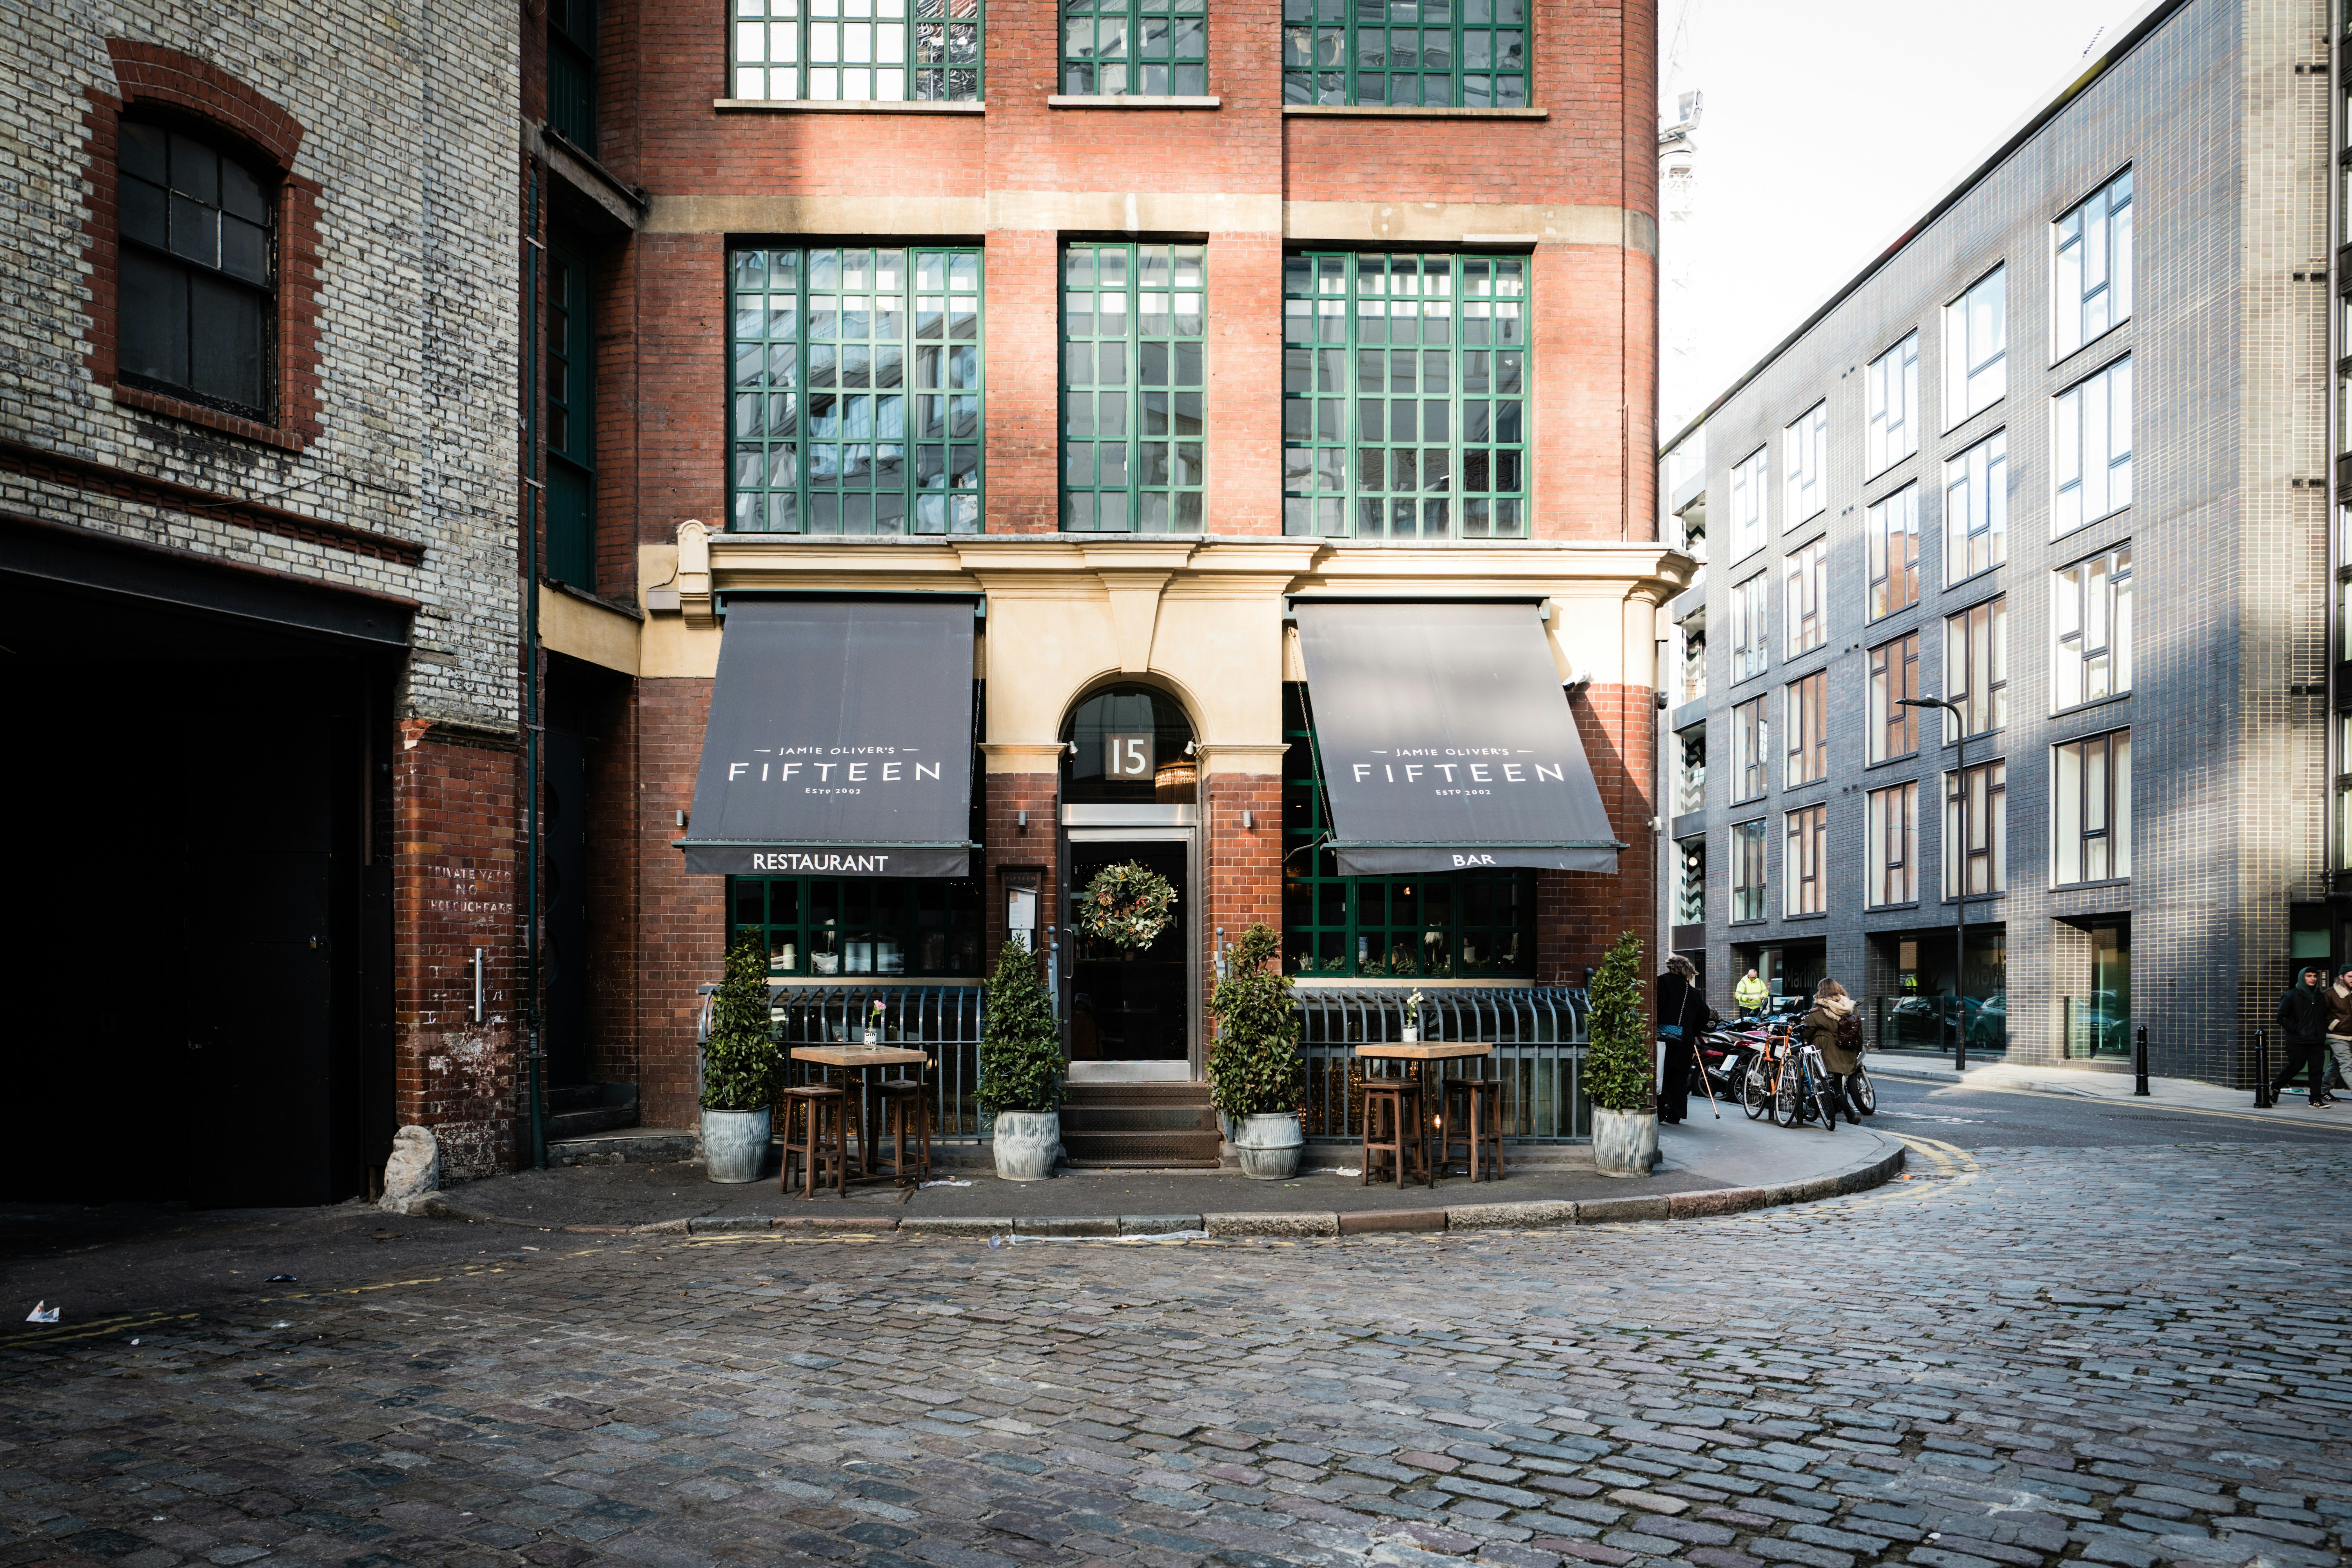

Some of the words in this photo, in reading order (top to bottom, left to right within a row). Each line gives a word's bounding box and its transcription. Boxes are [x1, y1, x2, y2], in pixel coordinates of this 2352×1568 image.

[779, 747, 822, 755] JAMIE
[830, 747, 895, 755] OLIVER'S
[1113, 739, 1146, 774] 15
[1396, 748, 1438, 757] JAMIE
[728, 762, 940, 782] FIFTEEN
[1352, 763, 1564, 782] FIFTEEN
[754, 853, 889, 871] RESTAURANT
[1452, 855, 1496, 867] BAR
